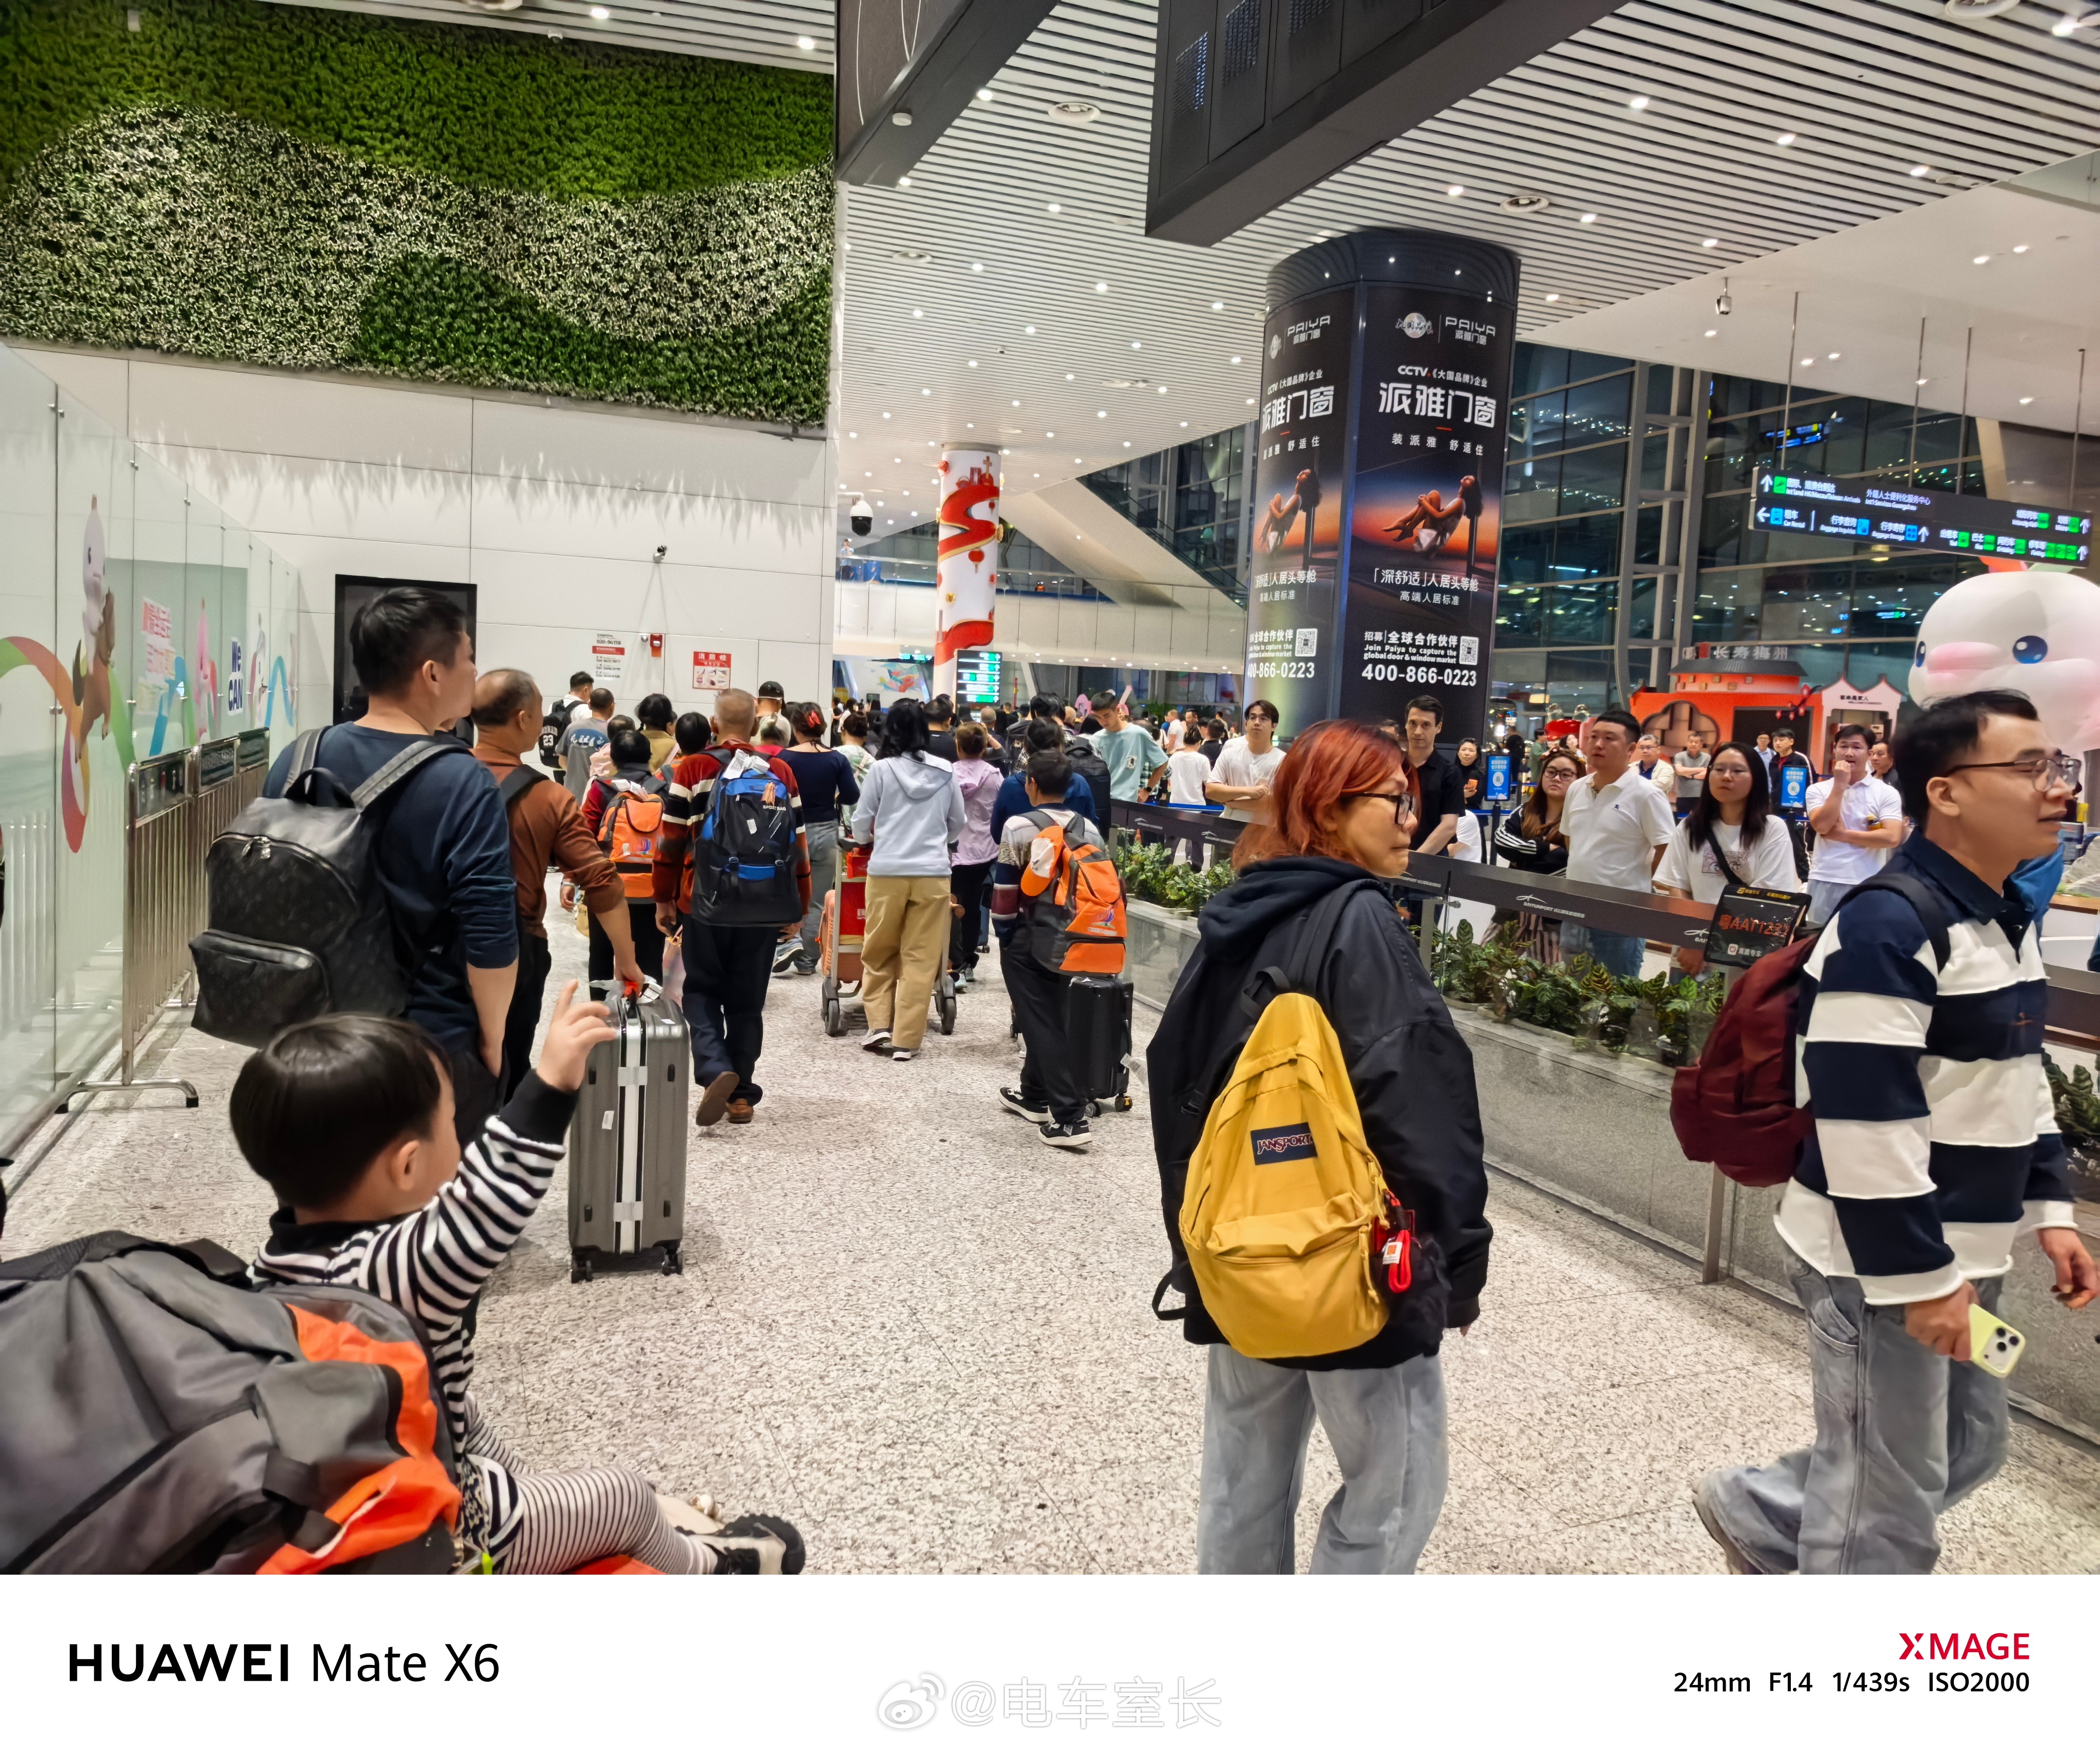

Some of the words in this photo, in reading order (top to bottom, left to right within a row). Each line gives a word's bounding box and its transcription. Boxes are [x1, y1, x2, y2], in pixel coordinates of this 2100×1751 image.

[1287, 315, 1330, 337] PAIYA
[1445, 316, 1496, 337] PAIYA
[1398, 365, 1428, 377] CCTV
[1262, 385, 1335, 435] 派雅门窗
[1378, 382, 1497, 427] 派雅门窗
[1391, 433, 1437, 448] 装派雅
[1449, 439, 1484, 456] 舒适住
[1374, 568, 1479, 592] 「深舒适」人居头等舱
[1400, 591, 1460, 606] 高端人居标准
[1364, 631, 1383, 641] 招募
[1388, 631, 1458, 648] 全球合作伙伴
[1385, 645, 1405, 654] Paiya
[1363, 651, 1386, 660] global
[1410, 654, 1436, 662] window
[1247, 662, 1315, 678] 400-866-0223
[1362, 663, 1477, 686] 400-866-0223
[228, 678, 243, 711] CAN
[542, 735, 554, 746] 23
[1257, 1133, 1312, 1155] JANSPORT
